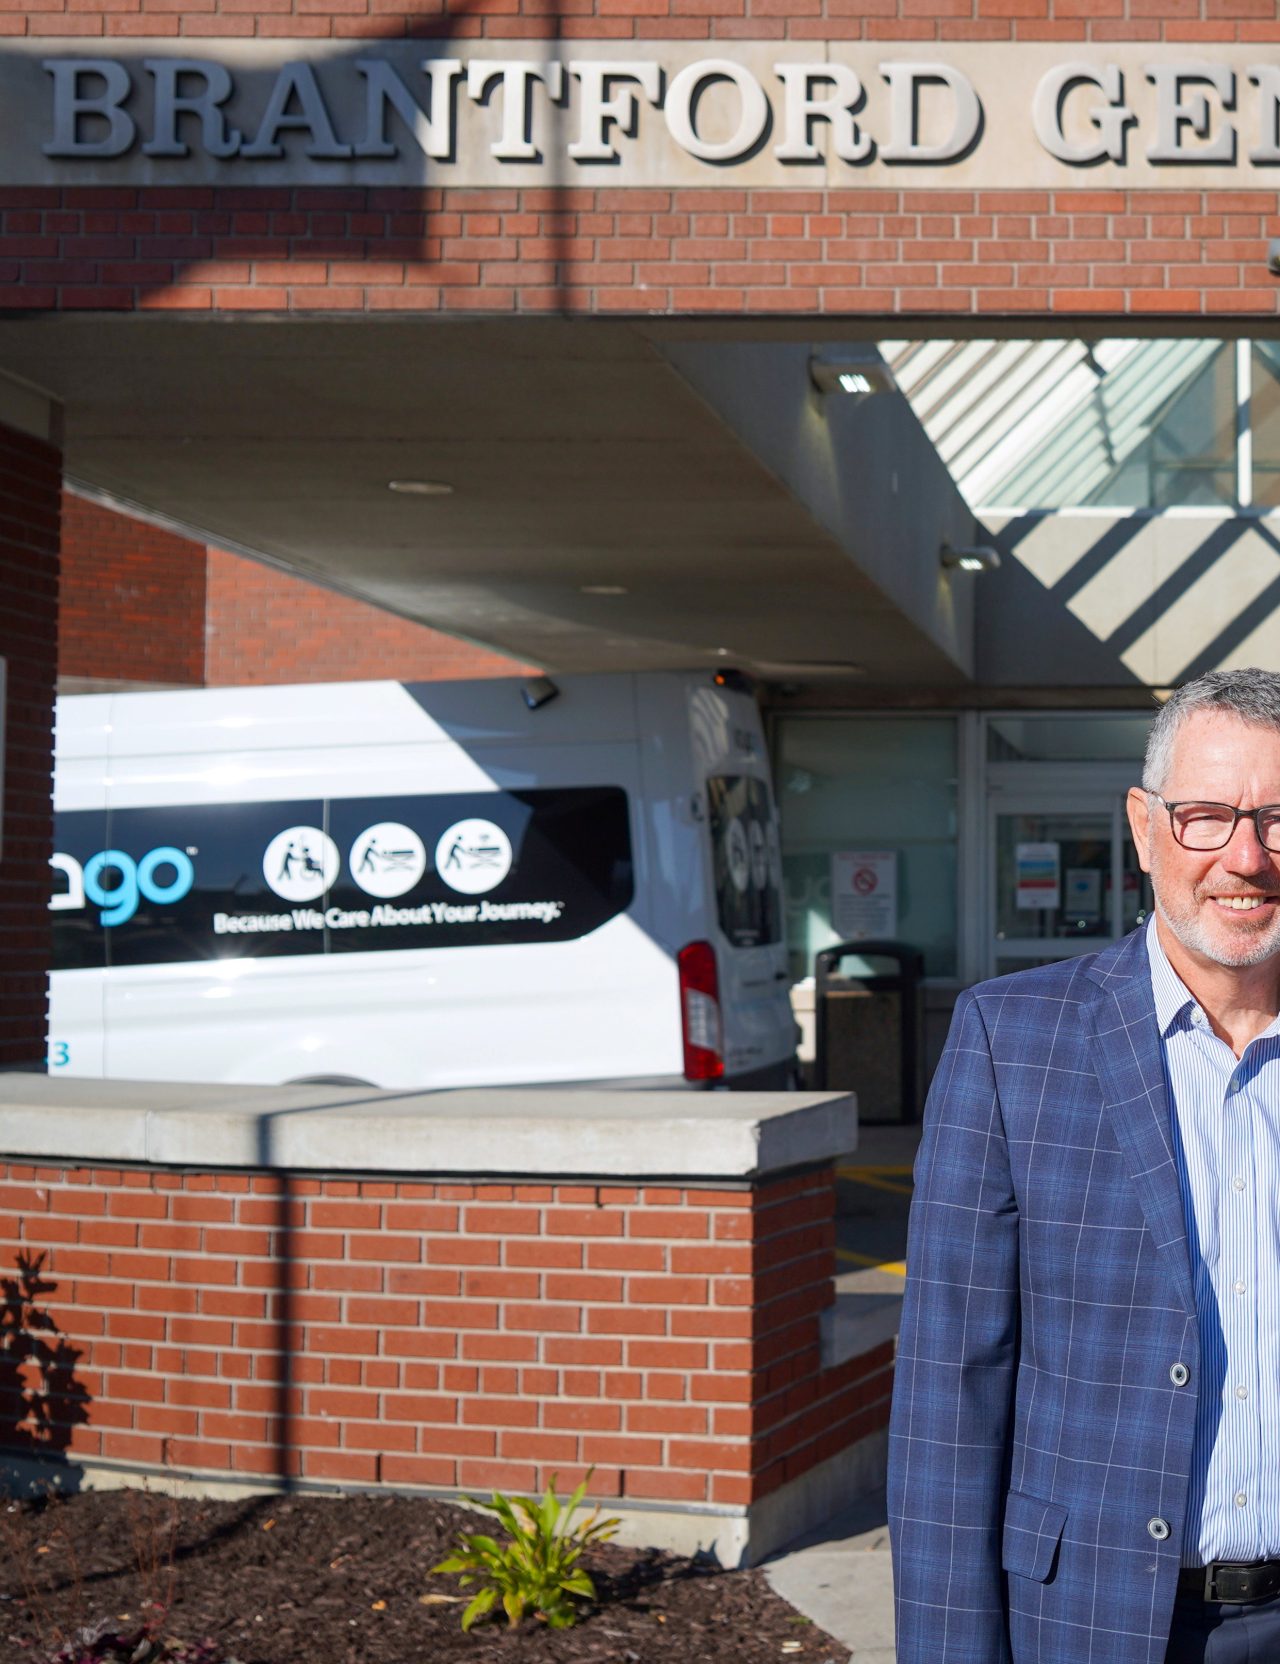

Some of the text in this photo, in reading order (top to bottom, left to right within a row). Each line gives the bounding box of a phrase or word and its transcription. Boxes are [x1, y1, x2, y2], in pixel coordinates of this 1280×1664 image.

[40, 57, 982, 168] BRANTFORD
[213, 912, 292, 934] Because
[292, 909, 323, 931] We
[324, 907, 371, 929] Care
[371, 904, 432, 928] About
[431, 903, 478, 925] Your
